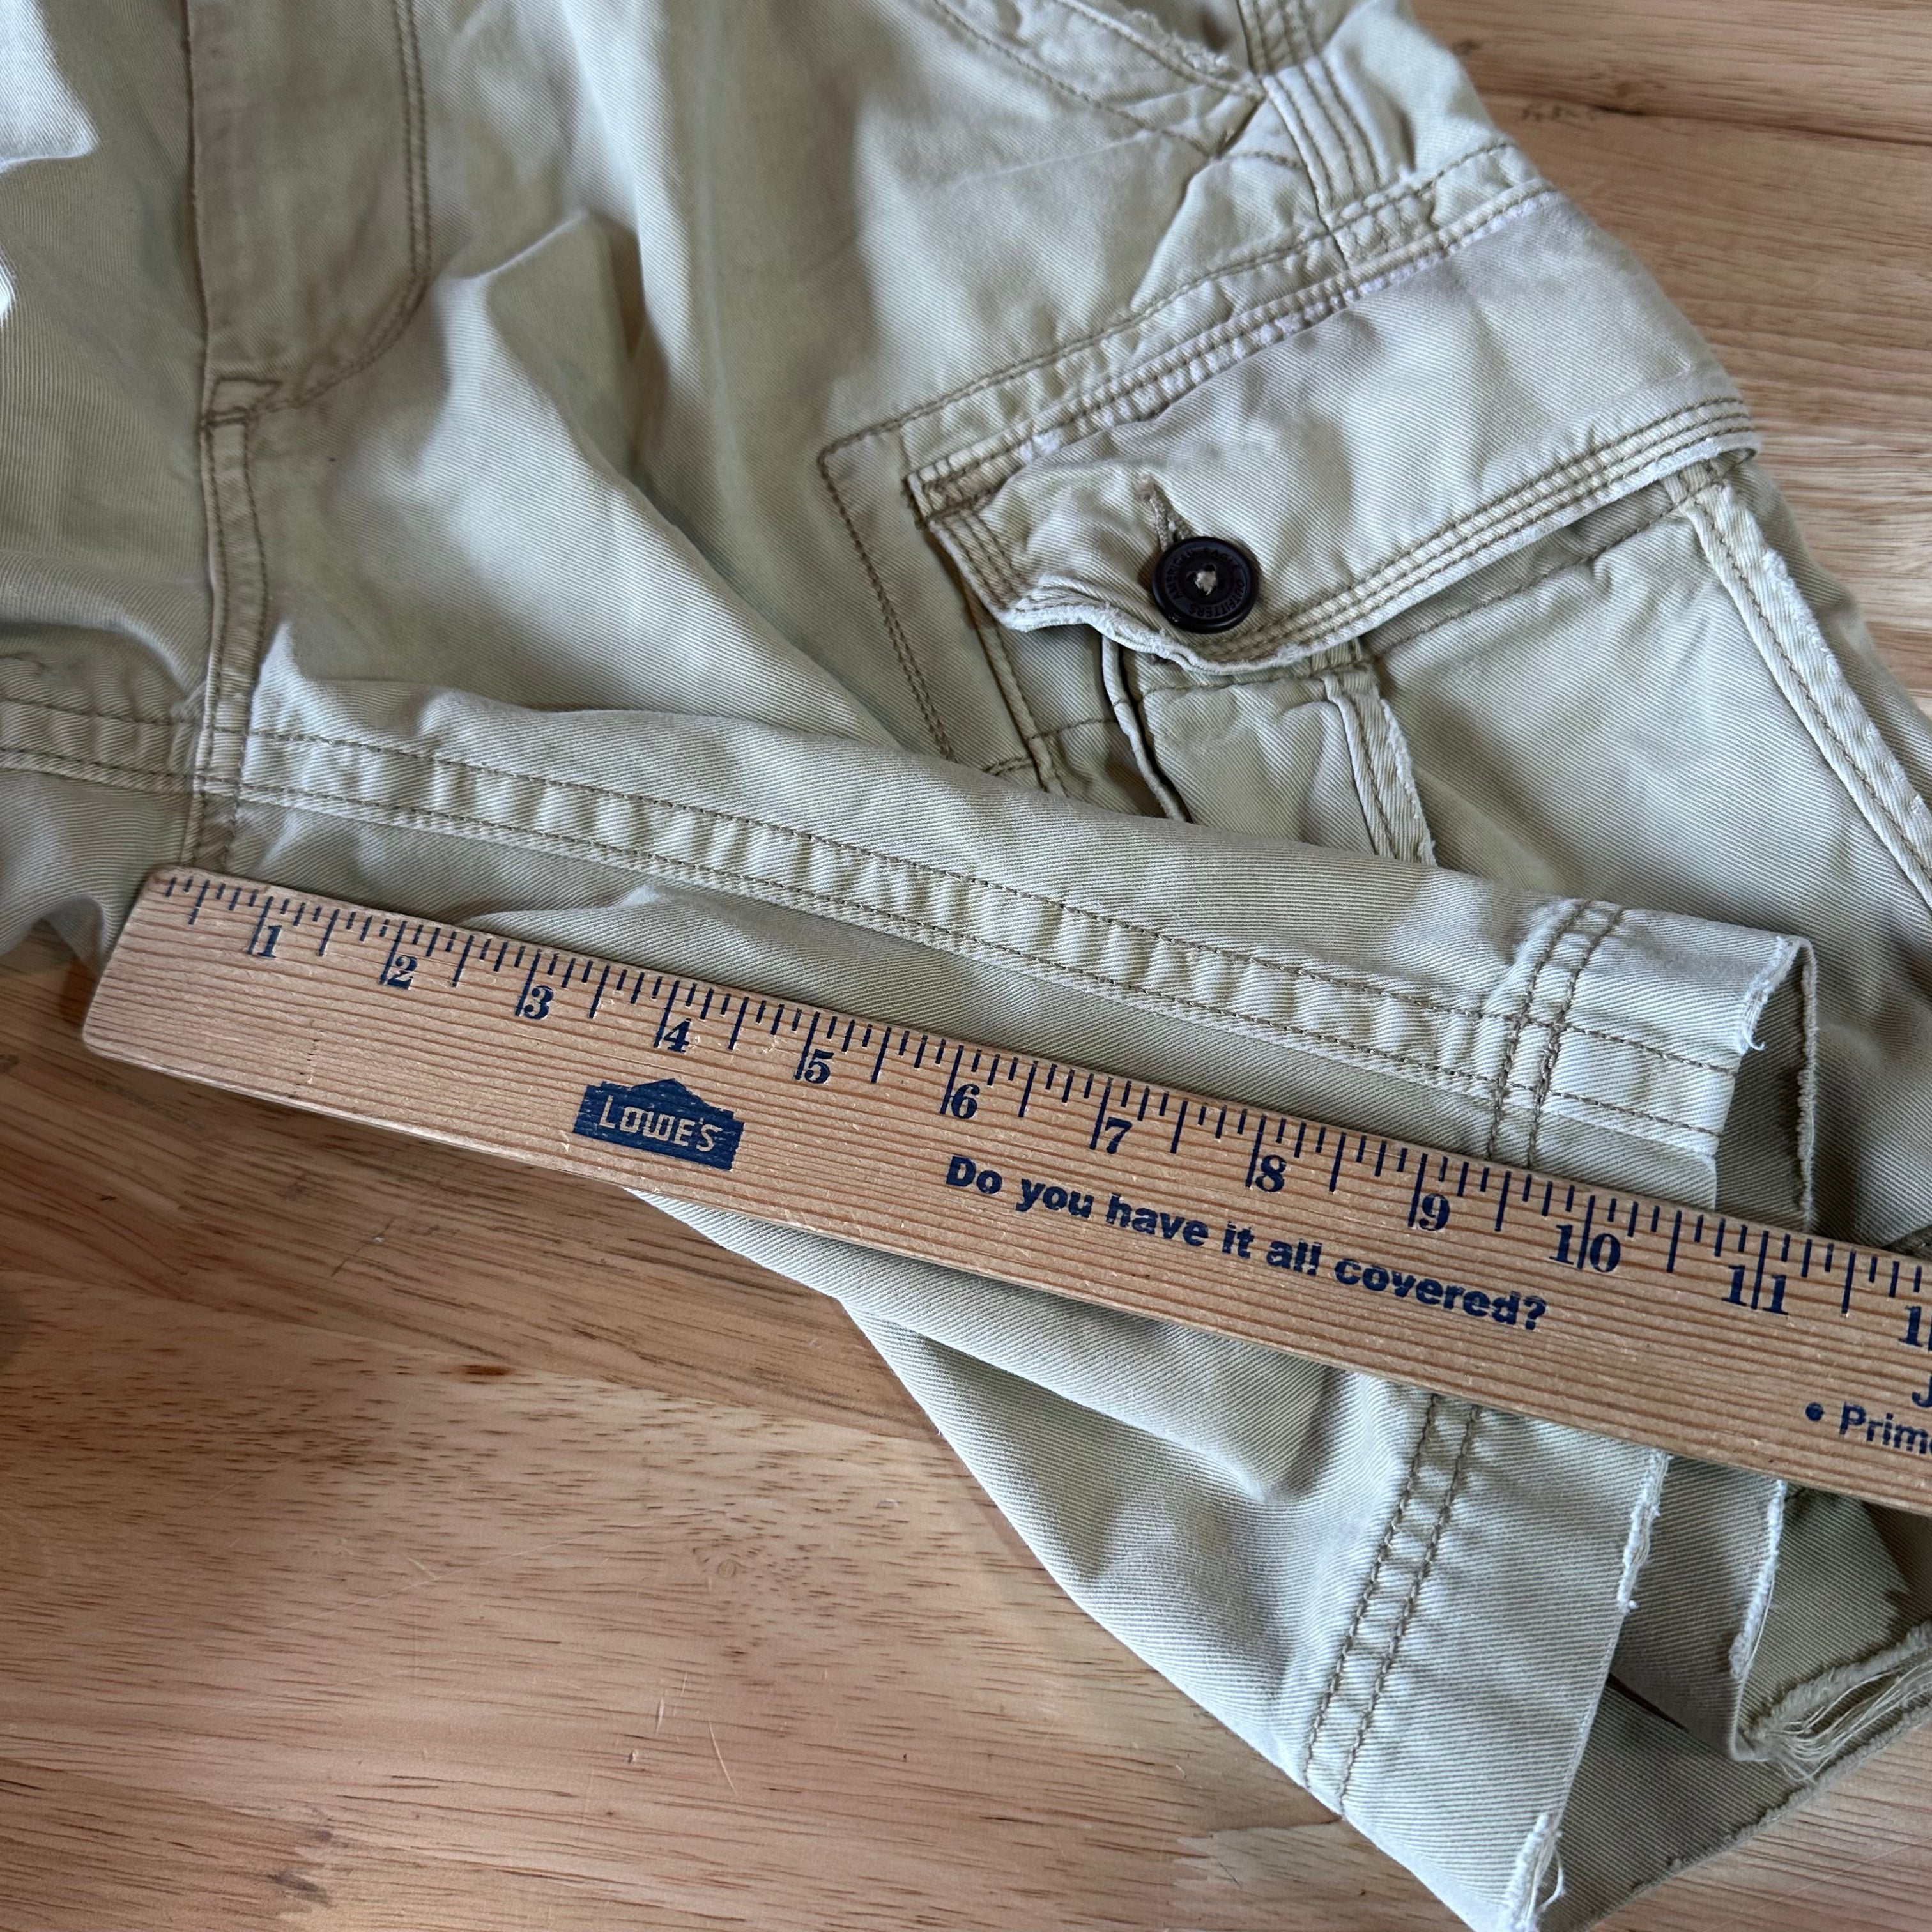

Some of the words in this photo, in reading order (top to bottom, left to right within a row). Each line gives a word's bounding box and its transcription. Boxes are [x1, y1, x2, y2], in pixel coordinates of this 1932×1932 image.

[1166, 549, 1195, 601] AMERICAN
[1188, 579, 1245, 618] OUTFITTERS
[260, 924, 283, 958] 1
[388, 955, 418, 988] 2
[523, 985, 554, 1020] 3
[663, 1018, 692, 1053] 4
[804, 1049, 834, 1084] 5
[951, 1084, 980, 1119] 6
[1105, 1117, 1132, 1154] 7
[1255, 1154, 1287, 1192] 8
[1418, 1193, 1450, 1231] 9
[1549, 1224, 1621, 1273] 10
[1722, 1264, 1789, 1315] 11
[1898, 1305, 1924, 1347] 1
[946, 1155, 1003, 1195] Do
[1016, 1178, 1094, 1218] you
[1106, 1192, 1209, 1246] have
[1222, 1221, 1255, 1259] it
[1266, 1239, 1322, 1275] all
[1335, 1258, 1547, 1330] covered?
[1839, 1402, 1932, 1455] Prim
